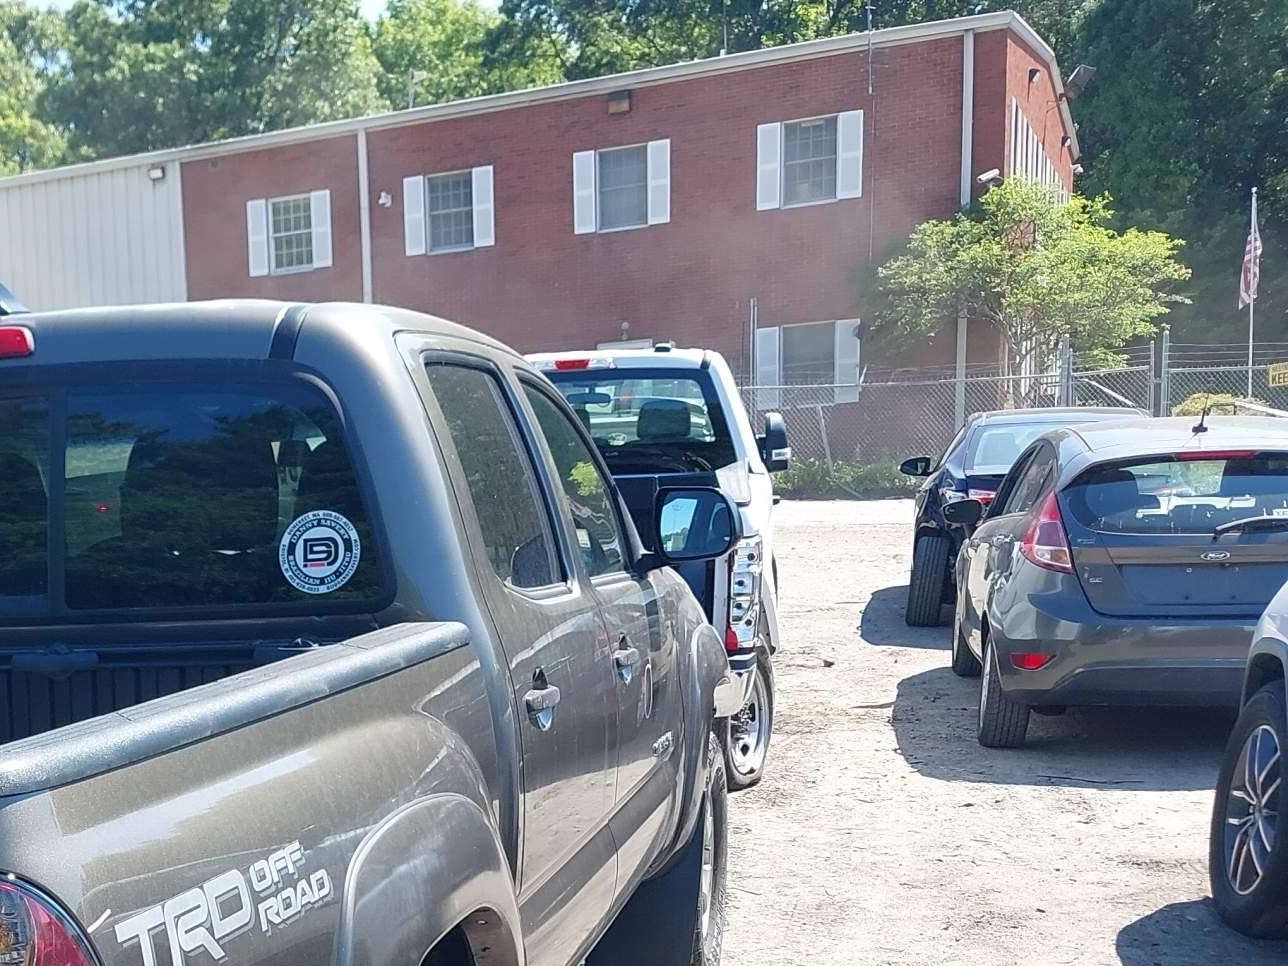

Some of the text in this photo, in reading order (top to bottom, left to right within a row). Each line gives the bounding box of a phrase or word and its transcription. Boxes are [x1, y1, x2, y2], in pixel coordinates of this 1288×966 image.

[290, 519, 350, 543] DANNY SAVERY
[288, 554, 320, 585] BRAZILIAN
[249, 840, 304, 894] OFF
[258, 869, 332, 934] ROAD
